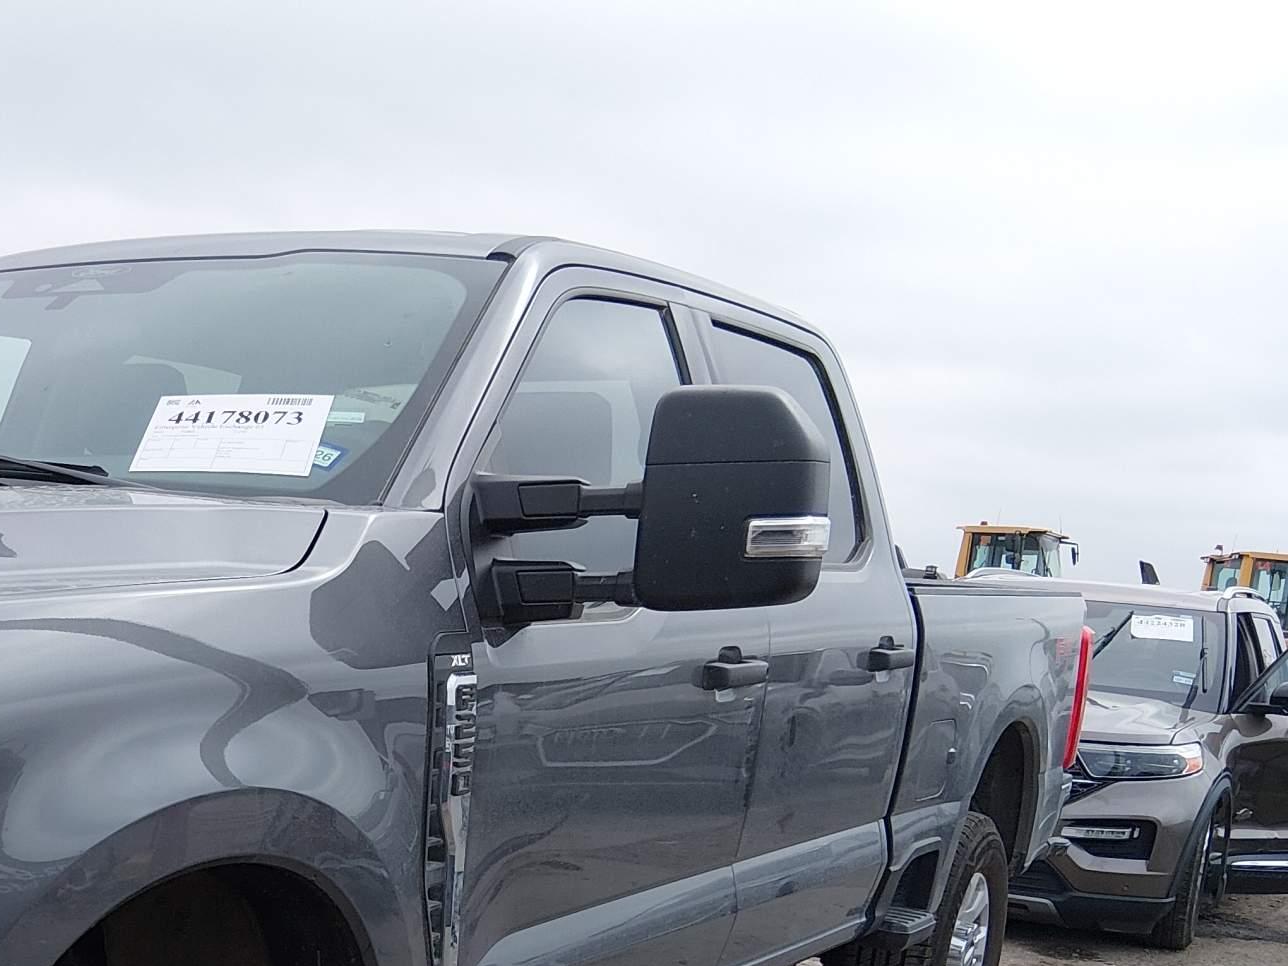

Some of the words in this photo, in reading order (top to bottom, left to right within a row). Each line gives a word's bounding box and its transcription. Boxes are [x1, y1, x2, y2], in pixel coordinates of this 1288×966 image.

[167, 410, 304, 426] 44178073
[315, 449, 334, 462] 26
[451, 653, 472, 667] XLT
